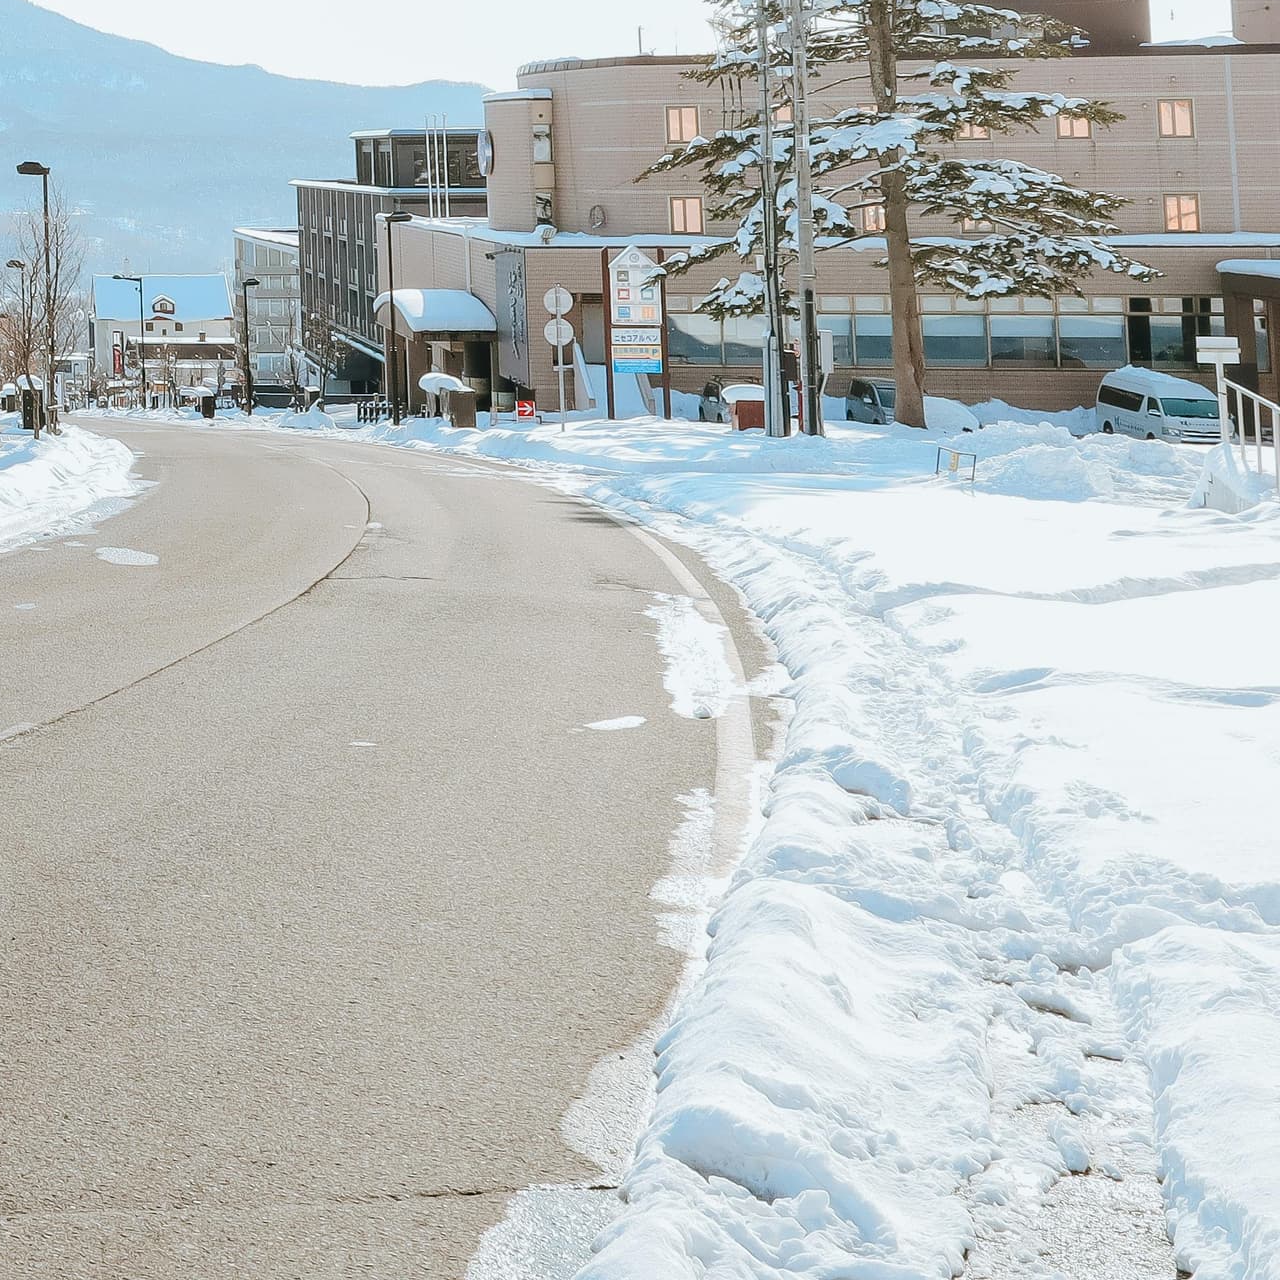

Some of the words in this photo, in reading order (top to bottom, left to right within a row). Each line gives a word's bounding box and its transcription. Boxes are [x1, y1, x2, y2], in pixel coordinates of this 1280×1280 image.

[614, 334, 658, 343] ニセコアルペン
